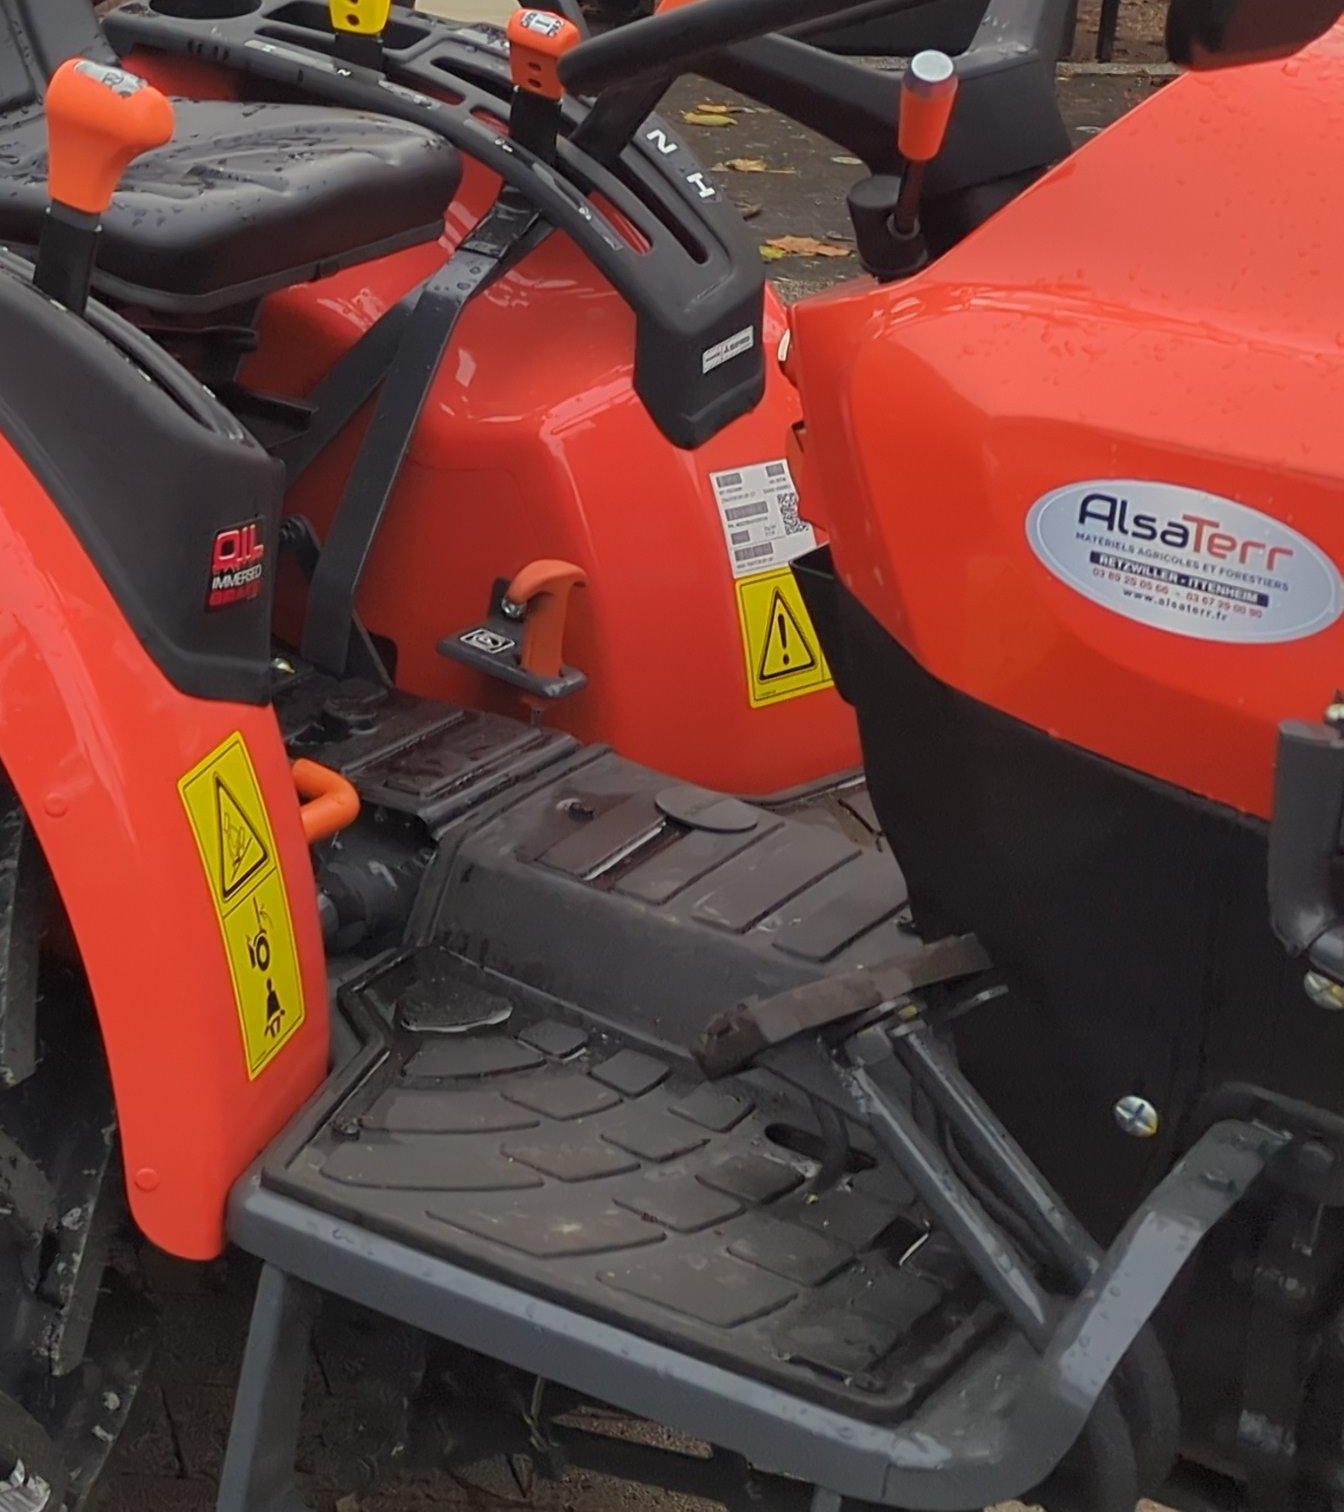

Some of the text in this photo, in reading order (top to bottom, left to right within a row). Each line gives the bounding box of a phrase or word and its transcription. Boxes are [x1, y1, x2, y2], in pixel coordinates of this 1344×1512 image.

[214, 524, 264, 563] OIL
[1078, 493, 1295, 571] AlsaTerr
[1099, 554, 1178, 584] RETZWILLER
[1137, 545, 1200, 570] AGRICOLES
[212, 564, 262, 589] IMMERSED
[1123, 588, 1228, 622] www.alsaterr.fr
